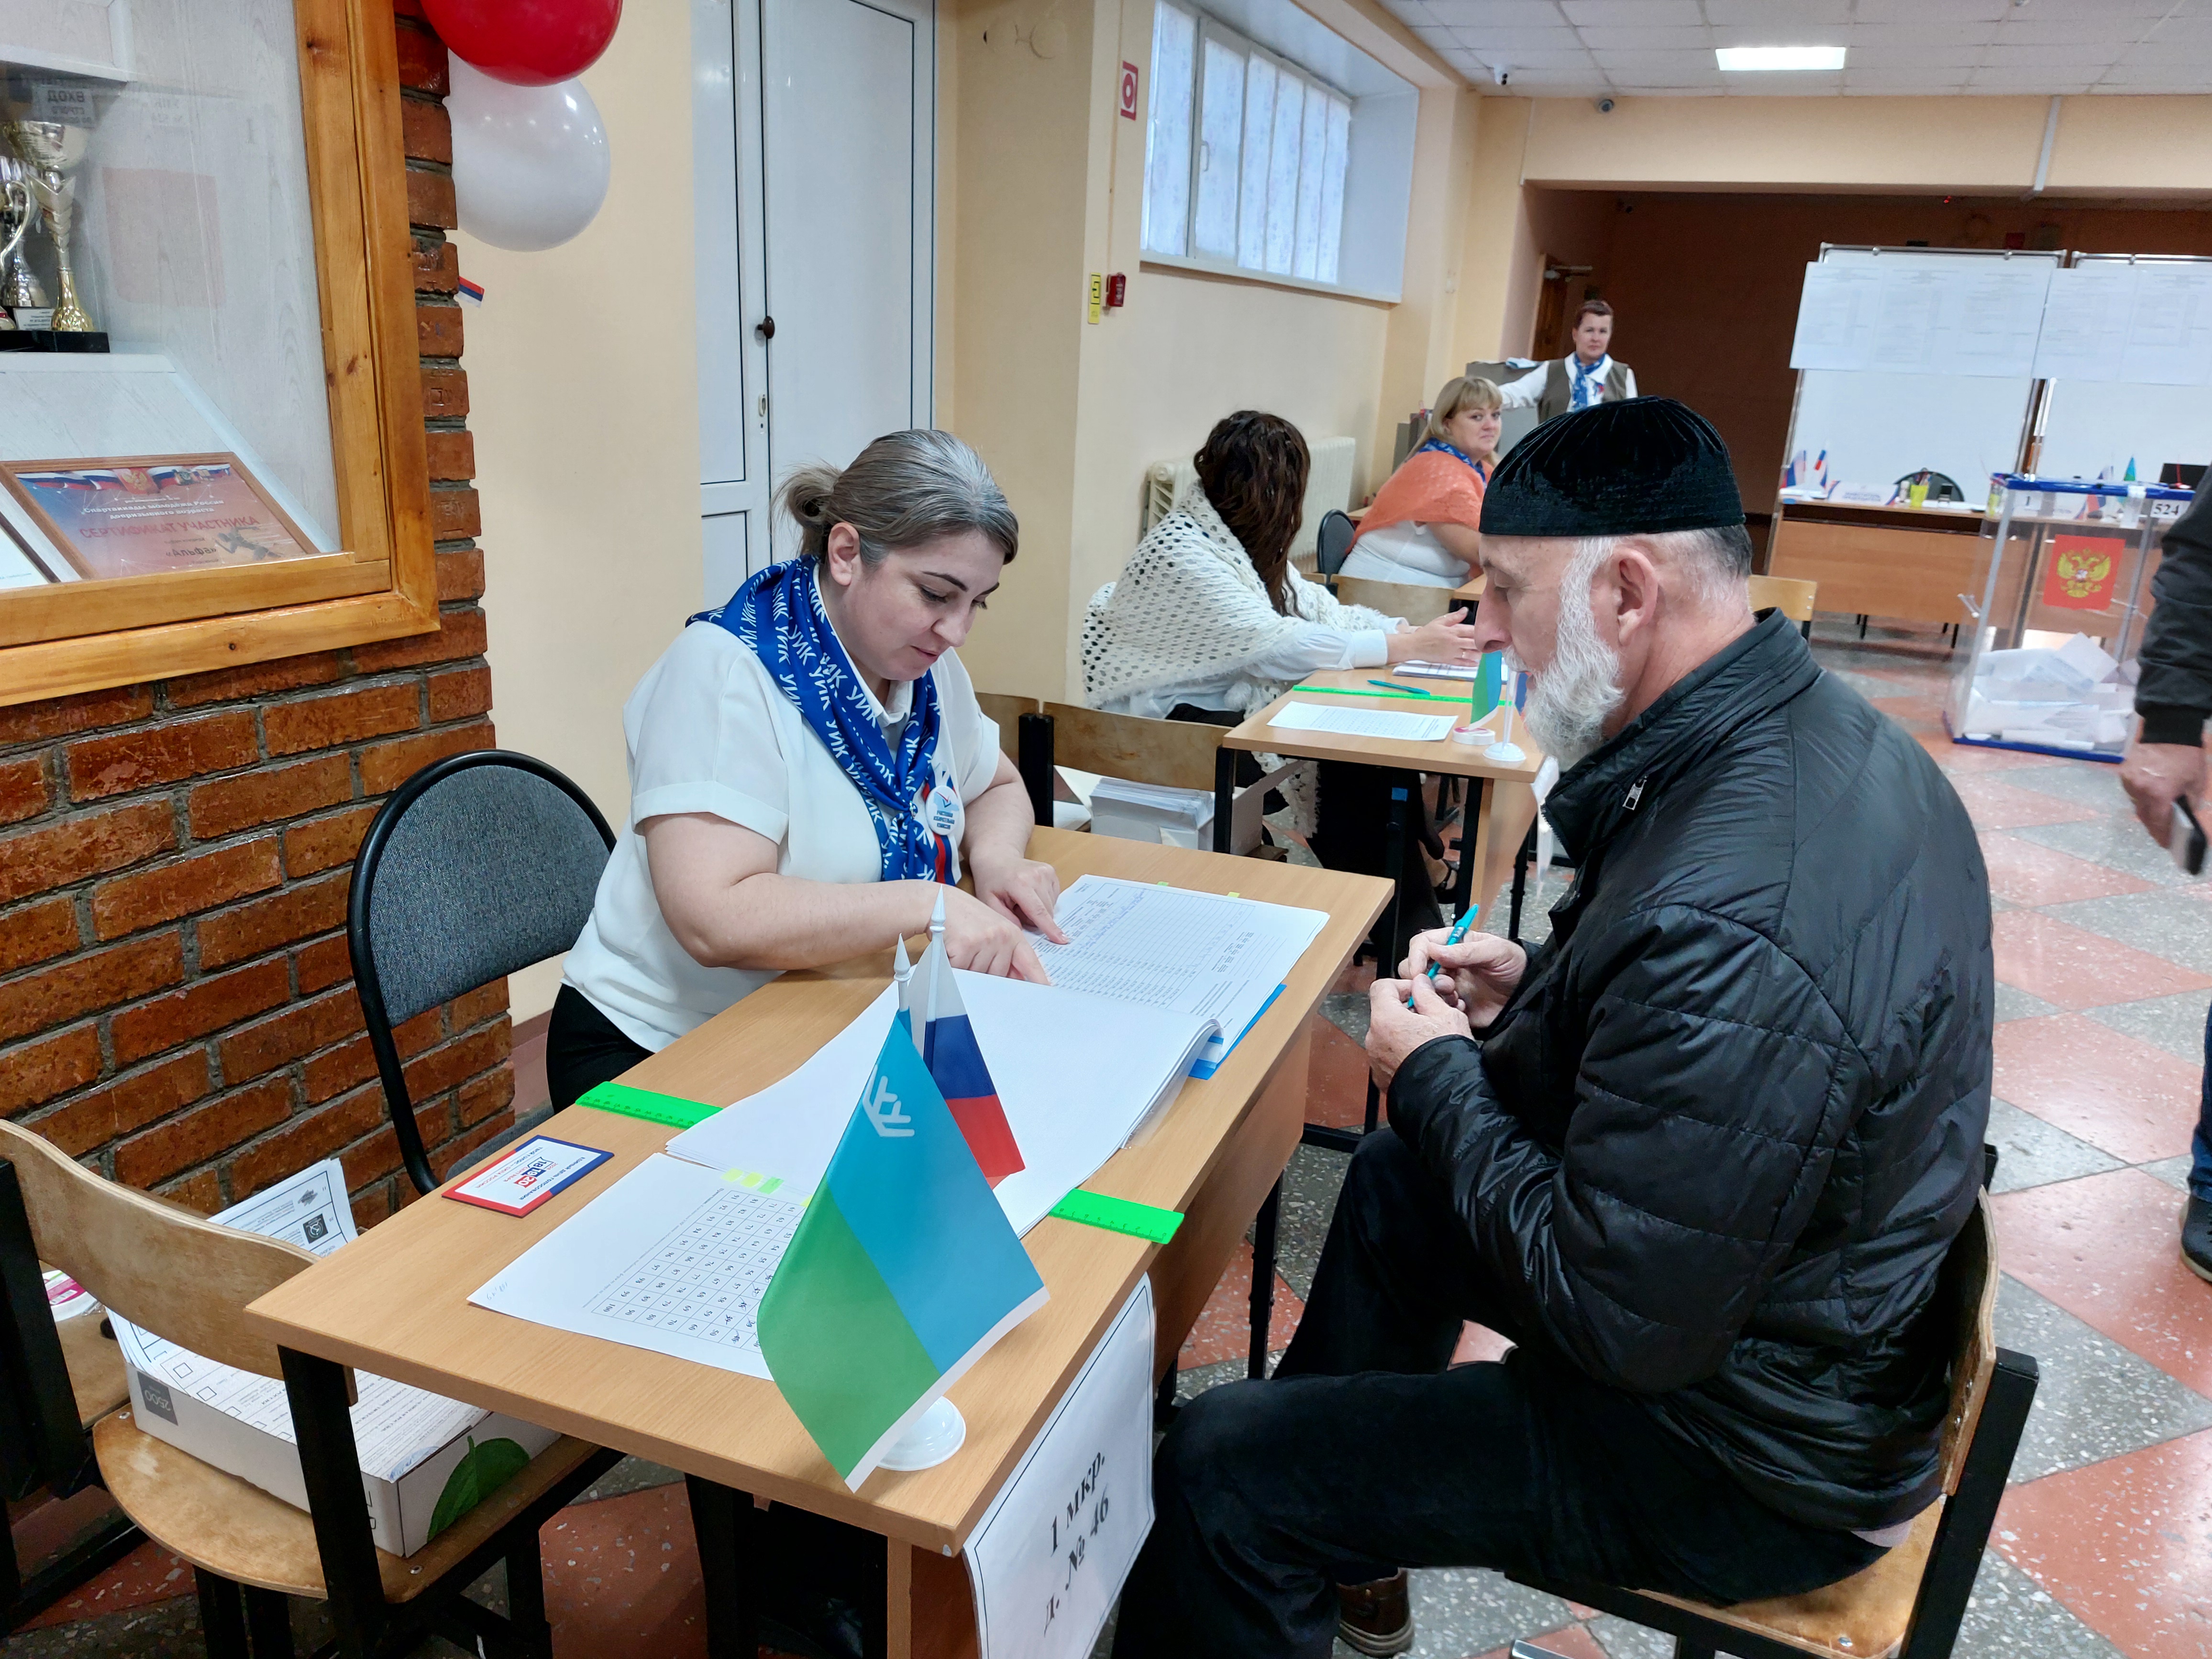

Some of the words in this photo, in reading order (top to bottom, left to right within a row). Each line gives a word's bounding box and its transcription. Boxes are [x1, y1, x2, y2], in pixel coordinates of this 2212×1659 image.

[2154, 503, 2179, 516] 524
[110, 510, 174, 520] допризывного
[79, 522, 176, 538] СЕРТИФИКАТ
[177, 516, 260, 531] УЧАСТНИКА
[166, 547, 217, 557] «Альфа»
[528, 1147, 543, 1155] ТВОЙ
[496, 1166, 512, 1175] СИЛА
[525, 1168, 542, 1176] 19
[551, 1169, 567, 1178] ДЕНЬ
[516, 1176, 536, 1186] 20
[518, 1177, 555, 1200] ГОЛОСОВАНИЯ
[144, 1390, 171, 1411] 2500
[1051, 1515, 1058, 1557] 1
[1066, 1452, 1105, 1530] мкр.
[1044, 1593, 1060, 1637] д.
[1065, 1535, 1085, 1591] №
[1090, 1482, 1109, 1537] 46
